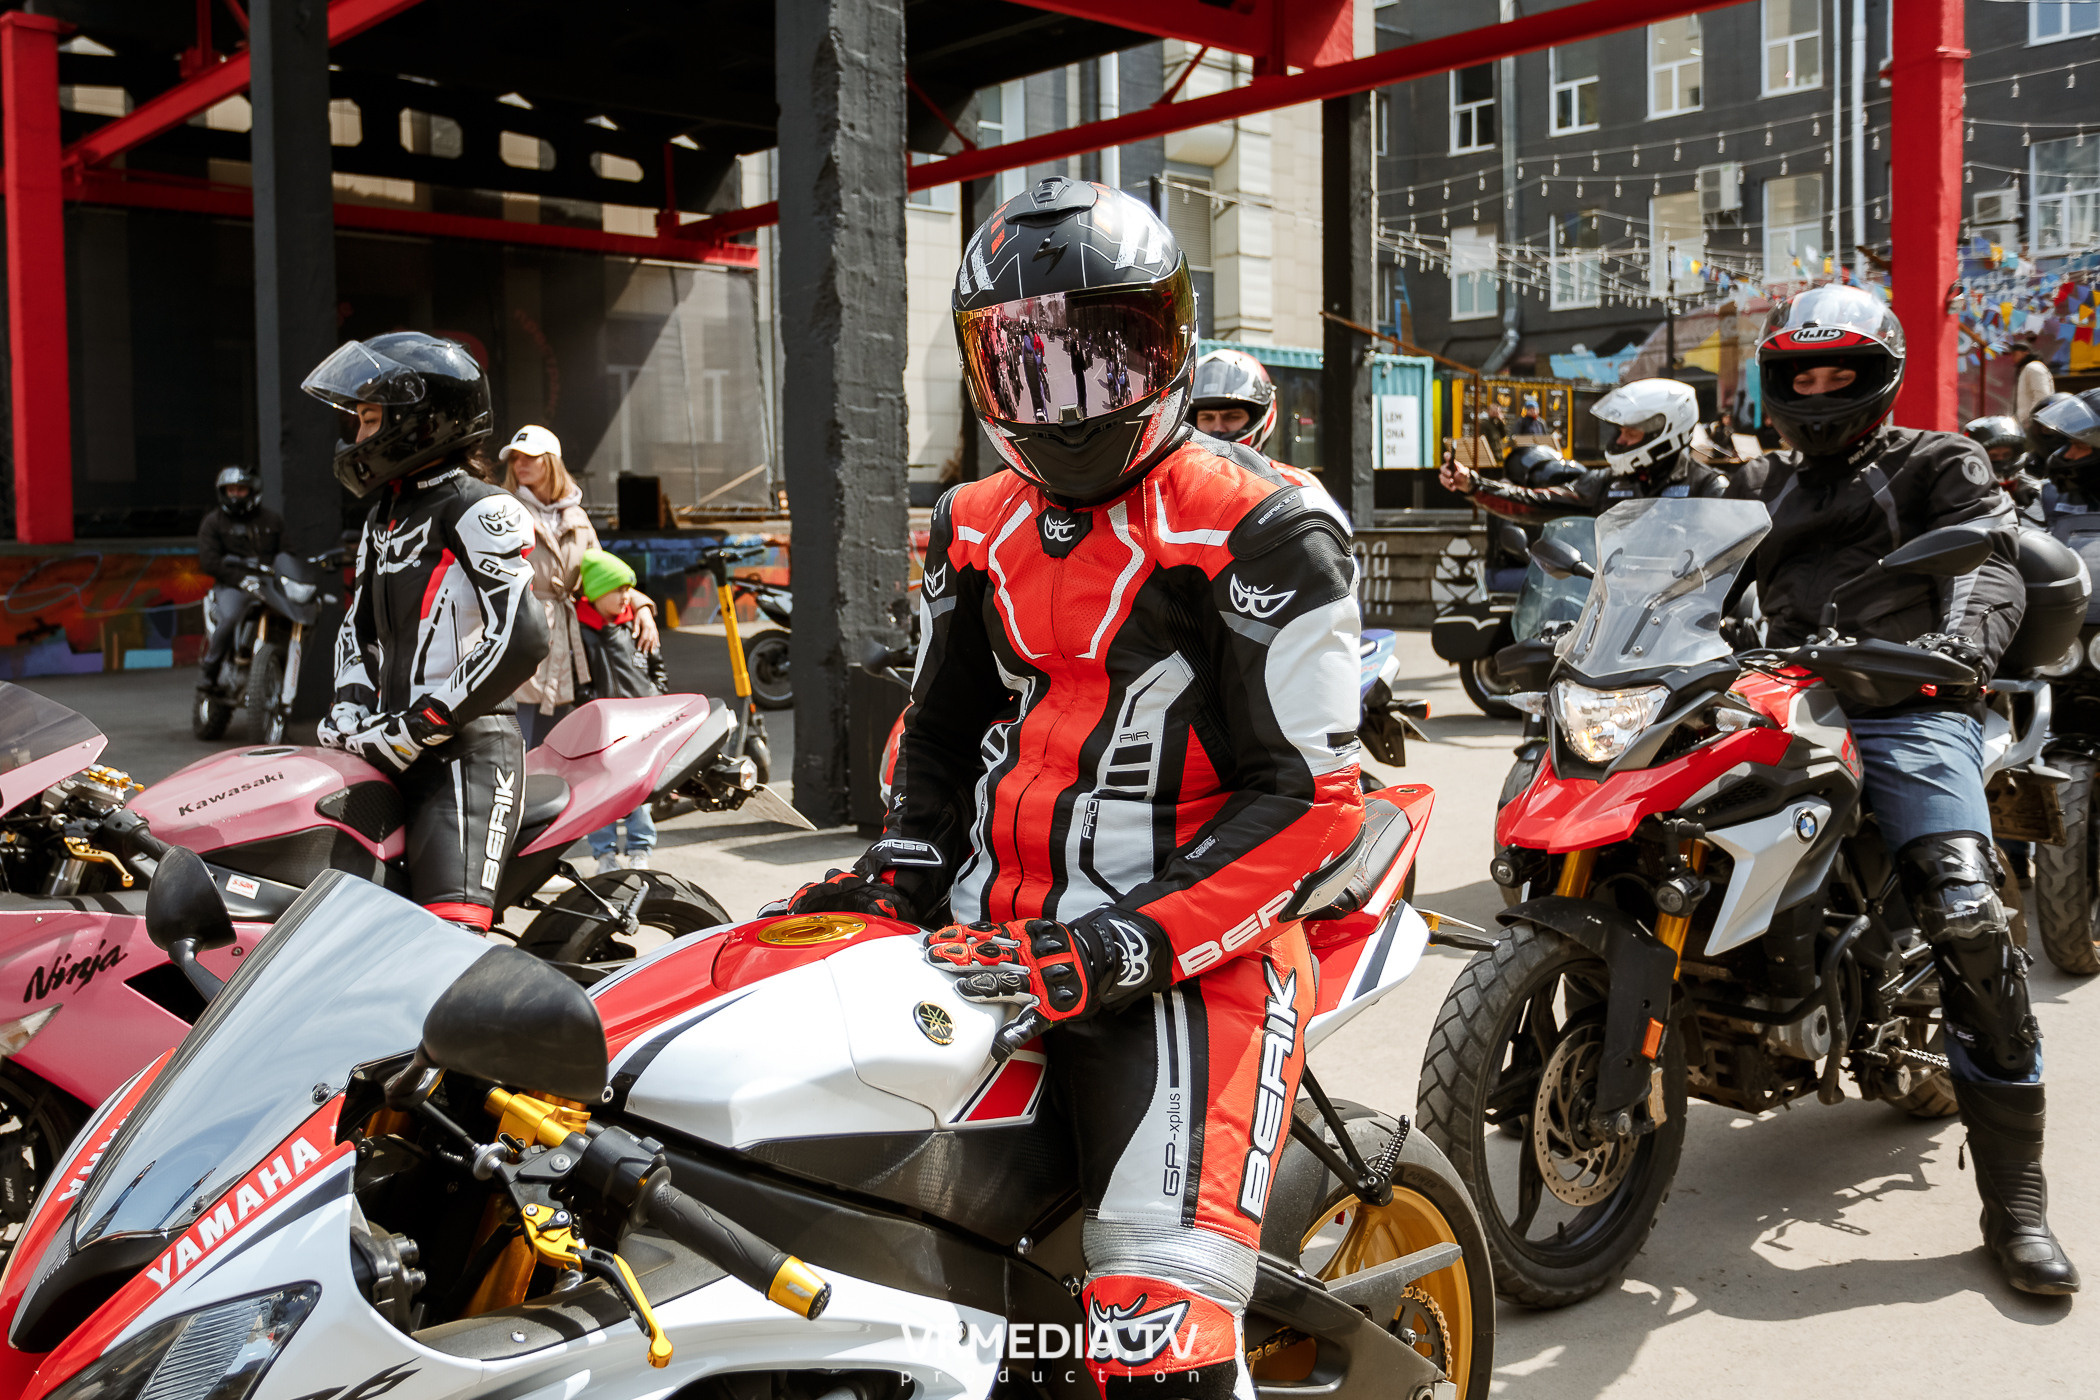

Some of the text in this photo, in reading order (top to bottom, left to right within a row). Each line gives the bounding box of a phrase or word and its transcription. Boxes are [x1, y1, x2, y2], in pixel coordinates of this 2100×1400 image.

[1797, 329, 1840, 340] HJC
[417, 467, 464, 489] BERIK
[1258, 502, 1285, 525] BERIK
[1119, 731, 1150, 743] AIR
[178, 771, 284, 817] Kawasaki
[480, 766, 515, 891] BERIK
[1082, 800, 1098, 839] PRO
[1177, 851, 1334, 977] BER
[23, 939, 128, 1003] Ninja
[1003, 1015, 1037, 1038] BERIK
[1238, 957, 1298, 1224] BERIK
[1163, 1093, 1183, 1197] GP-xplus
[146, 1136, 322, 1290] YAMAHA
